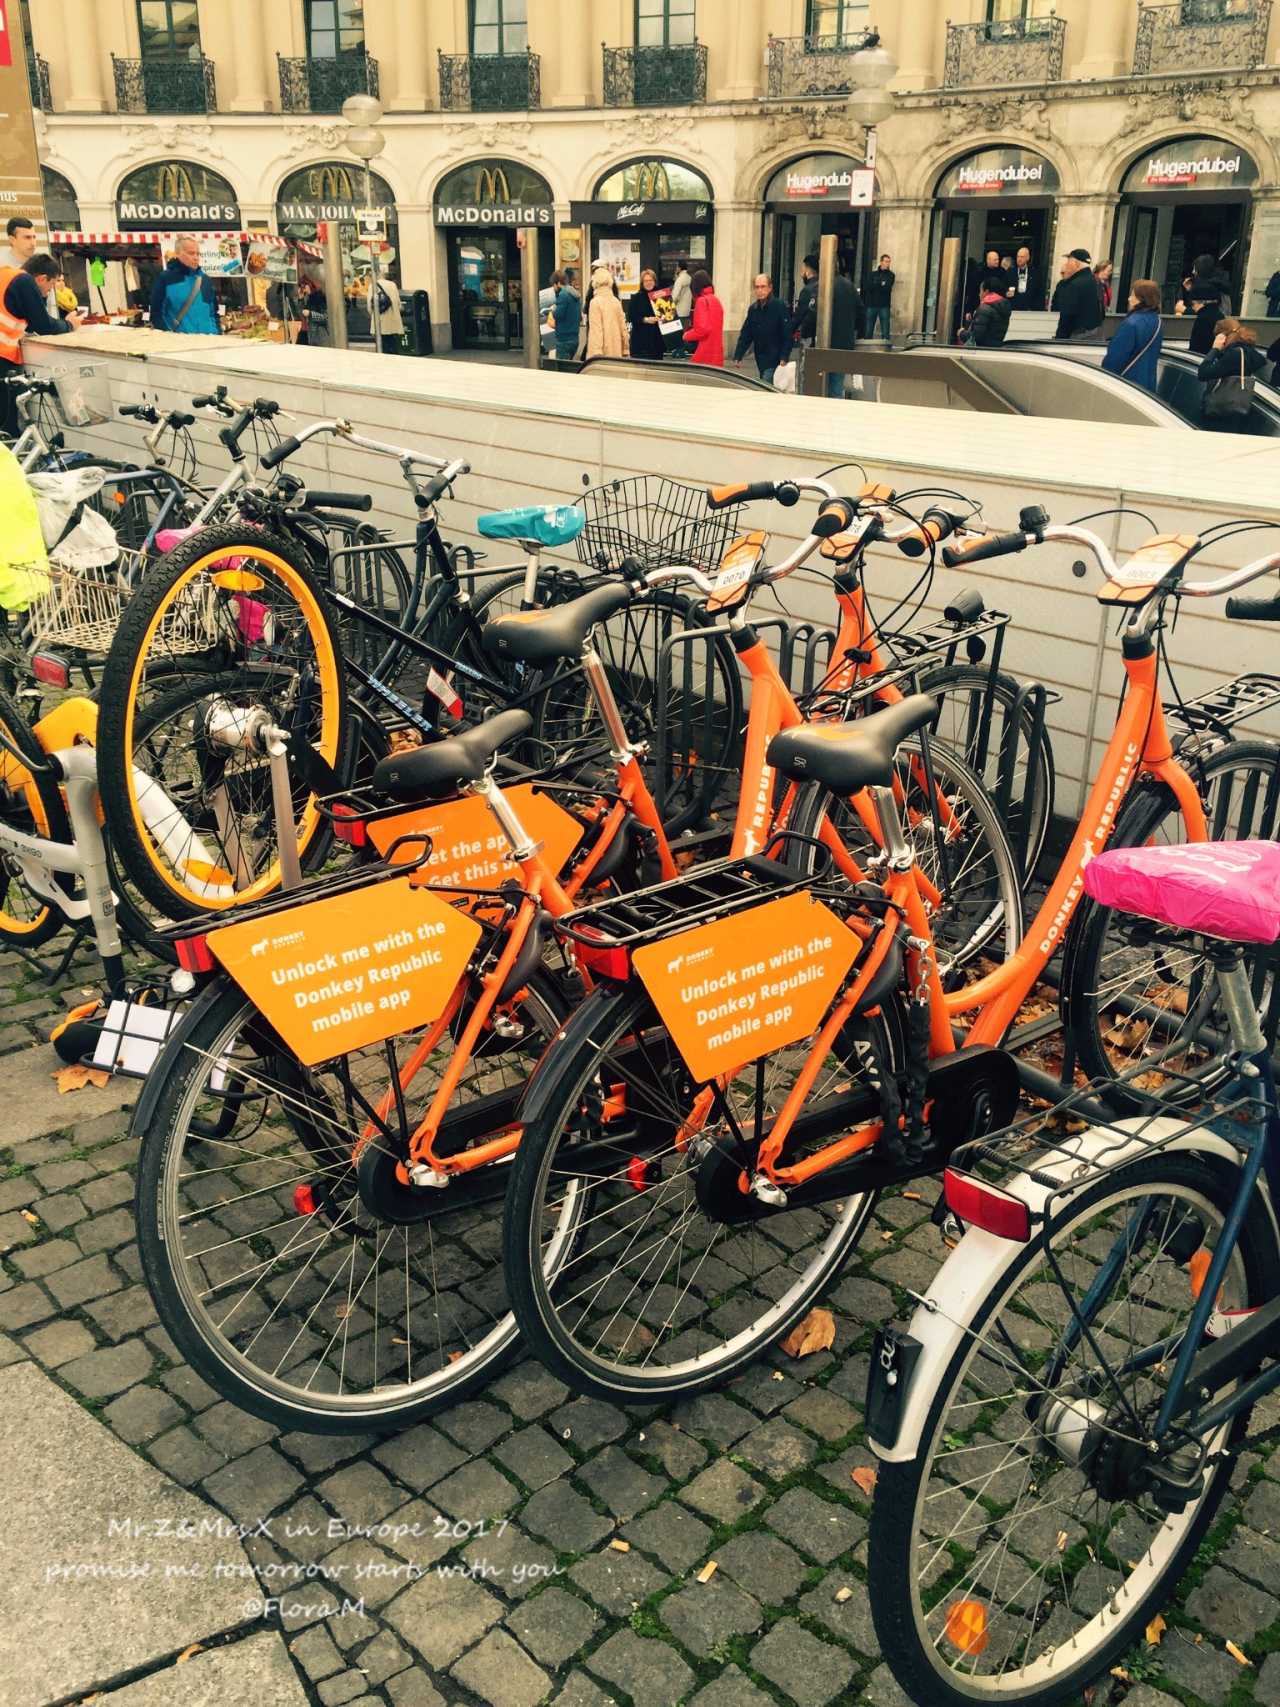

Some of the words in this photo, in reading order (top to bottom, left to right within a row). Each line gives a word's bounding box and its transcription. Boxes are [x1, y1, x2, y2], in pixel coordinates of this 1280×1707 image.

[786, 171, 852, 189] Hugendub
[959, 164, 1042, 184] Hugendubel
[1145, 155, 1240, 176] Hugendubel
[120, 203, 235, 220] McDonald's
[437, 207, 550, 223] McDonald's
[451, 841, 482, 860] the
[1040, 875, 1084, 953] DONKEY
[1094, 742, 1137, 839] REPUBLIC
[465, 860, 498, 882] this
[271, 952, 338, 986] Unlock
[341, 947, 370, 965] me
[373, 930, 414, 953] with
[417, 921, 446, 941] the
[681, 971, 737, 1004] Unlock
[741, 963, 766, 981] me
[769, 947, 804, 969] with
[807, 935, 833, 954] the
[294, 975, 364, 1009] Donkey
[368, 950, 443, 984] Republic
[696, 991, 757, 1026] Donkey
[760, 965, 824, 1000] Republic
[311, 1002, 375, 1033] mobile
[378, 989, 411, 1011] app
[707, 1016, 761, 1050] mobile
[765, 1005, 793, 1026] app
